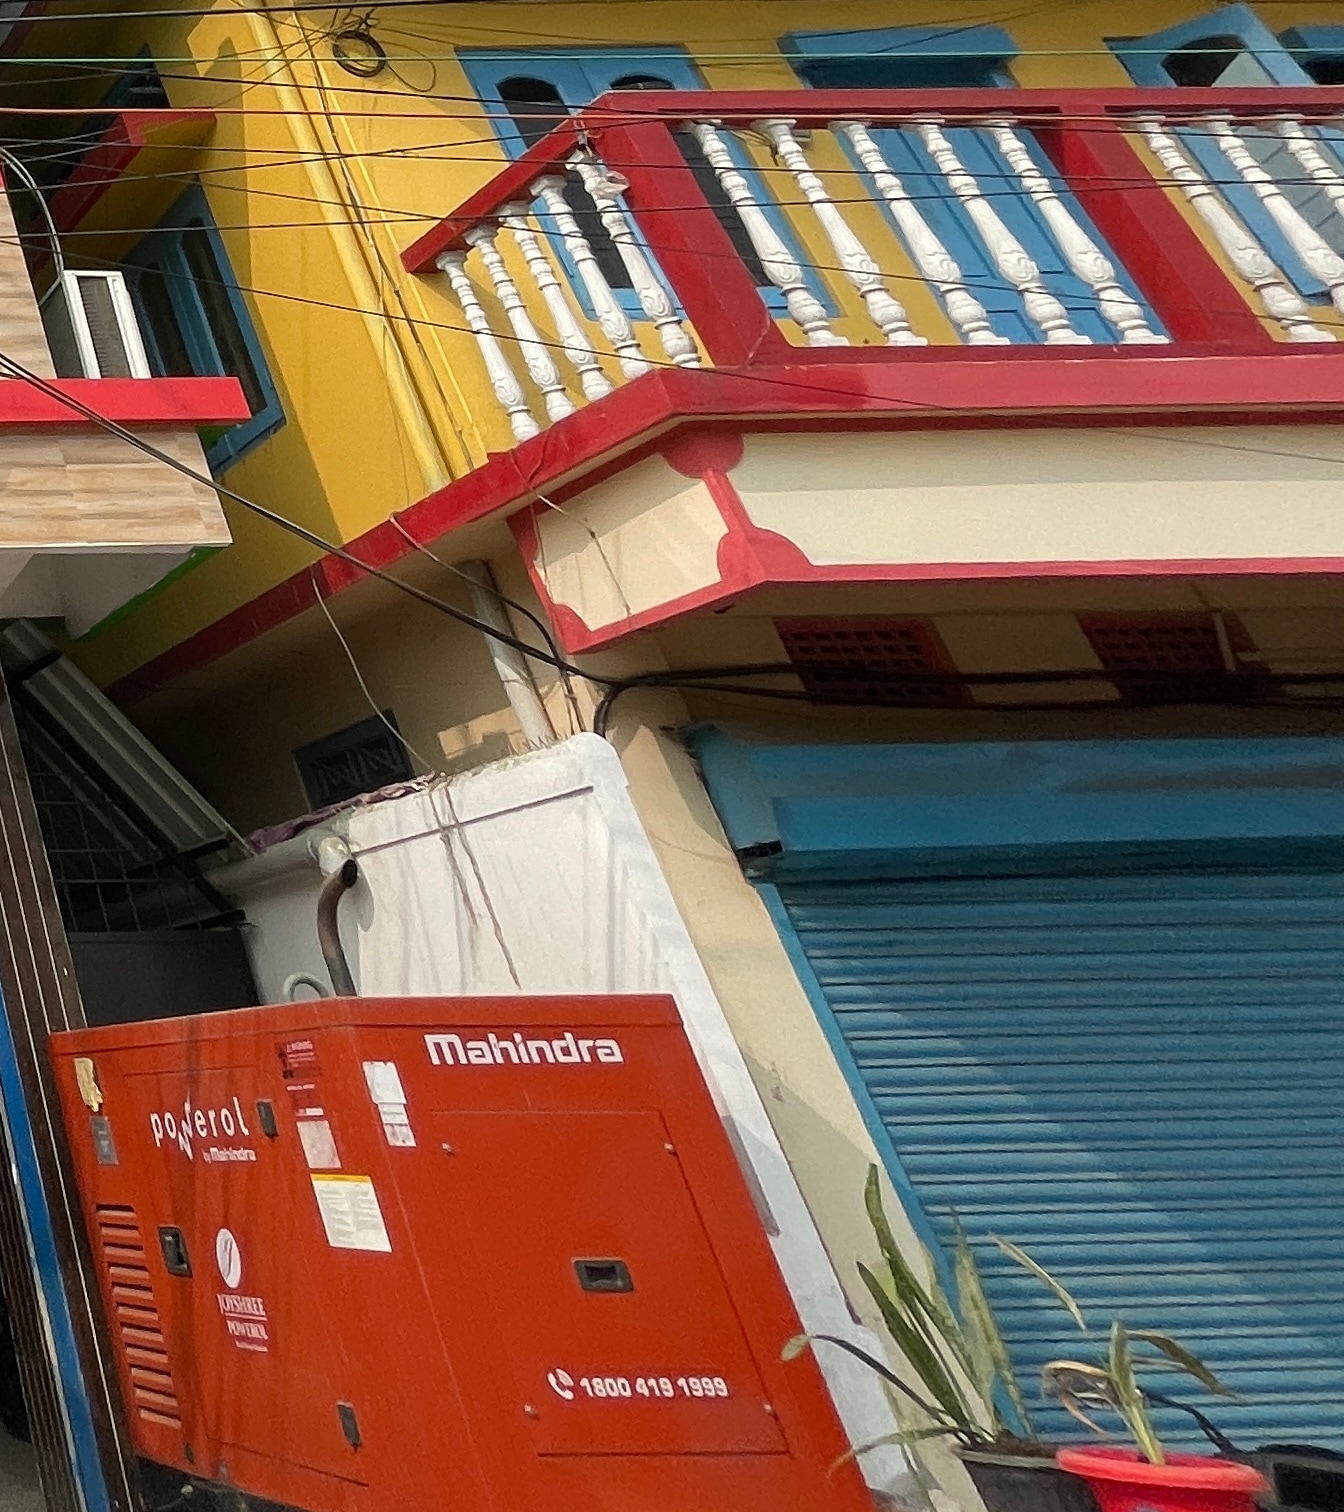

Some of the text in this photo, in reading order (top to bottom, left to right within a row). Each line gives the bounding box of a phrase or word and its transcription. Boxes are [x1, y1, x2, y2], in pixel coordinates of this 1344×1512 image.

[424, 1032, 624, 1065] Mahindra
[580, 1377, 729, 1398] 1800 419 1999
